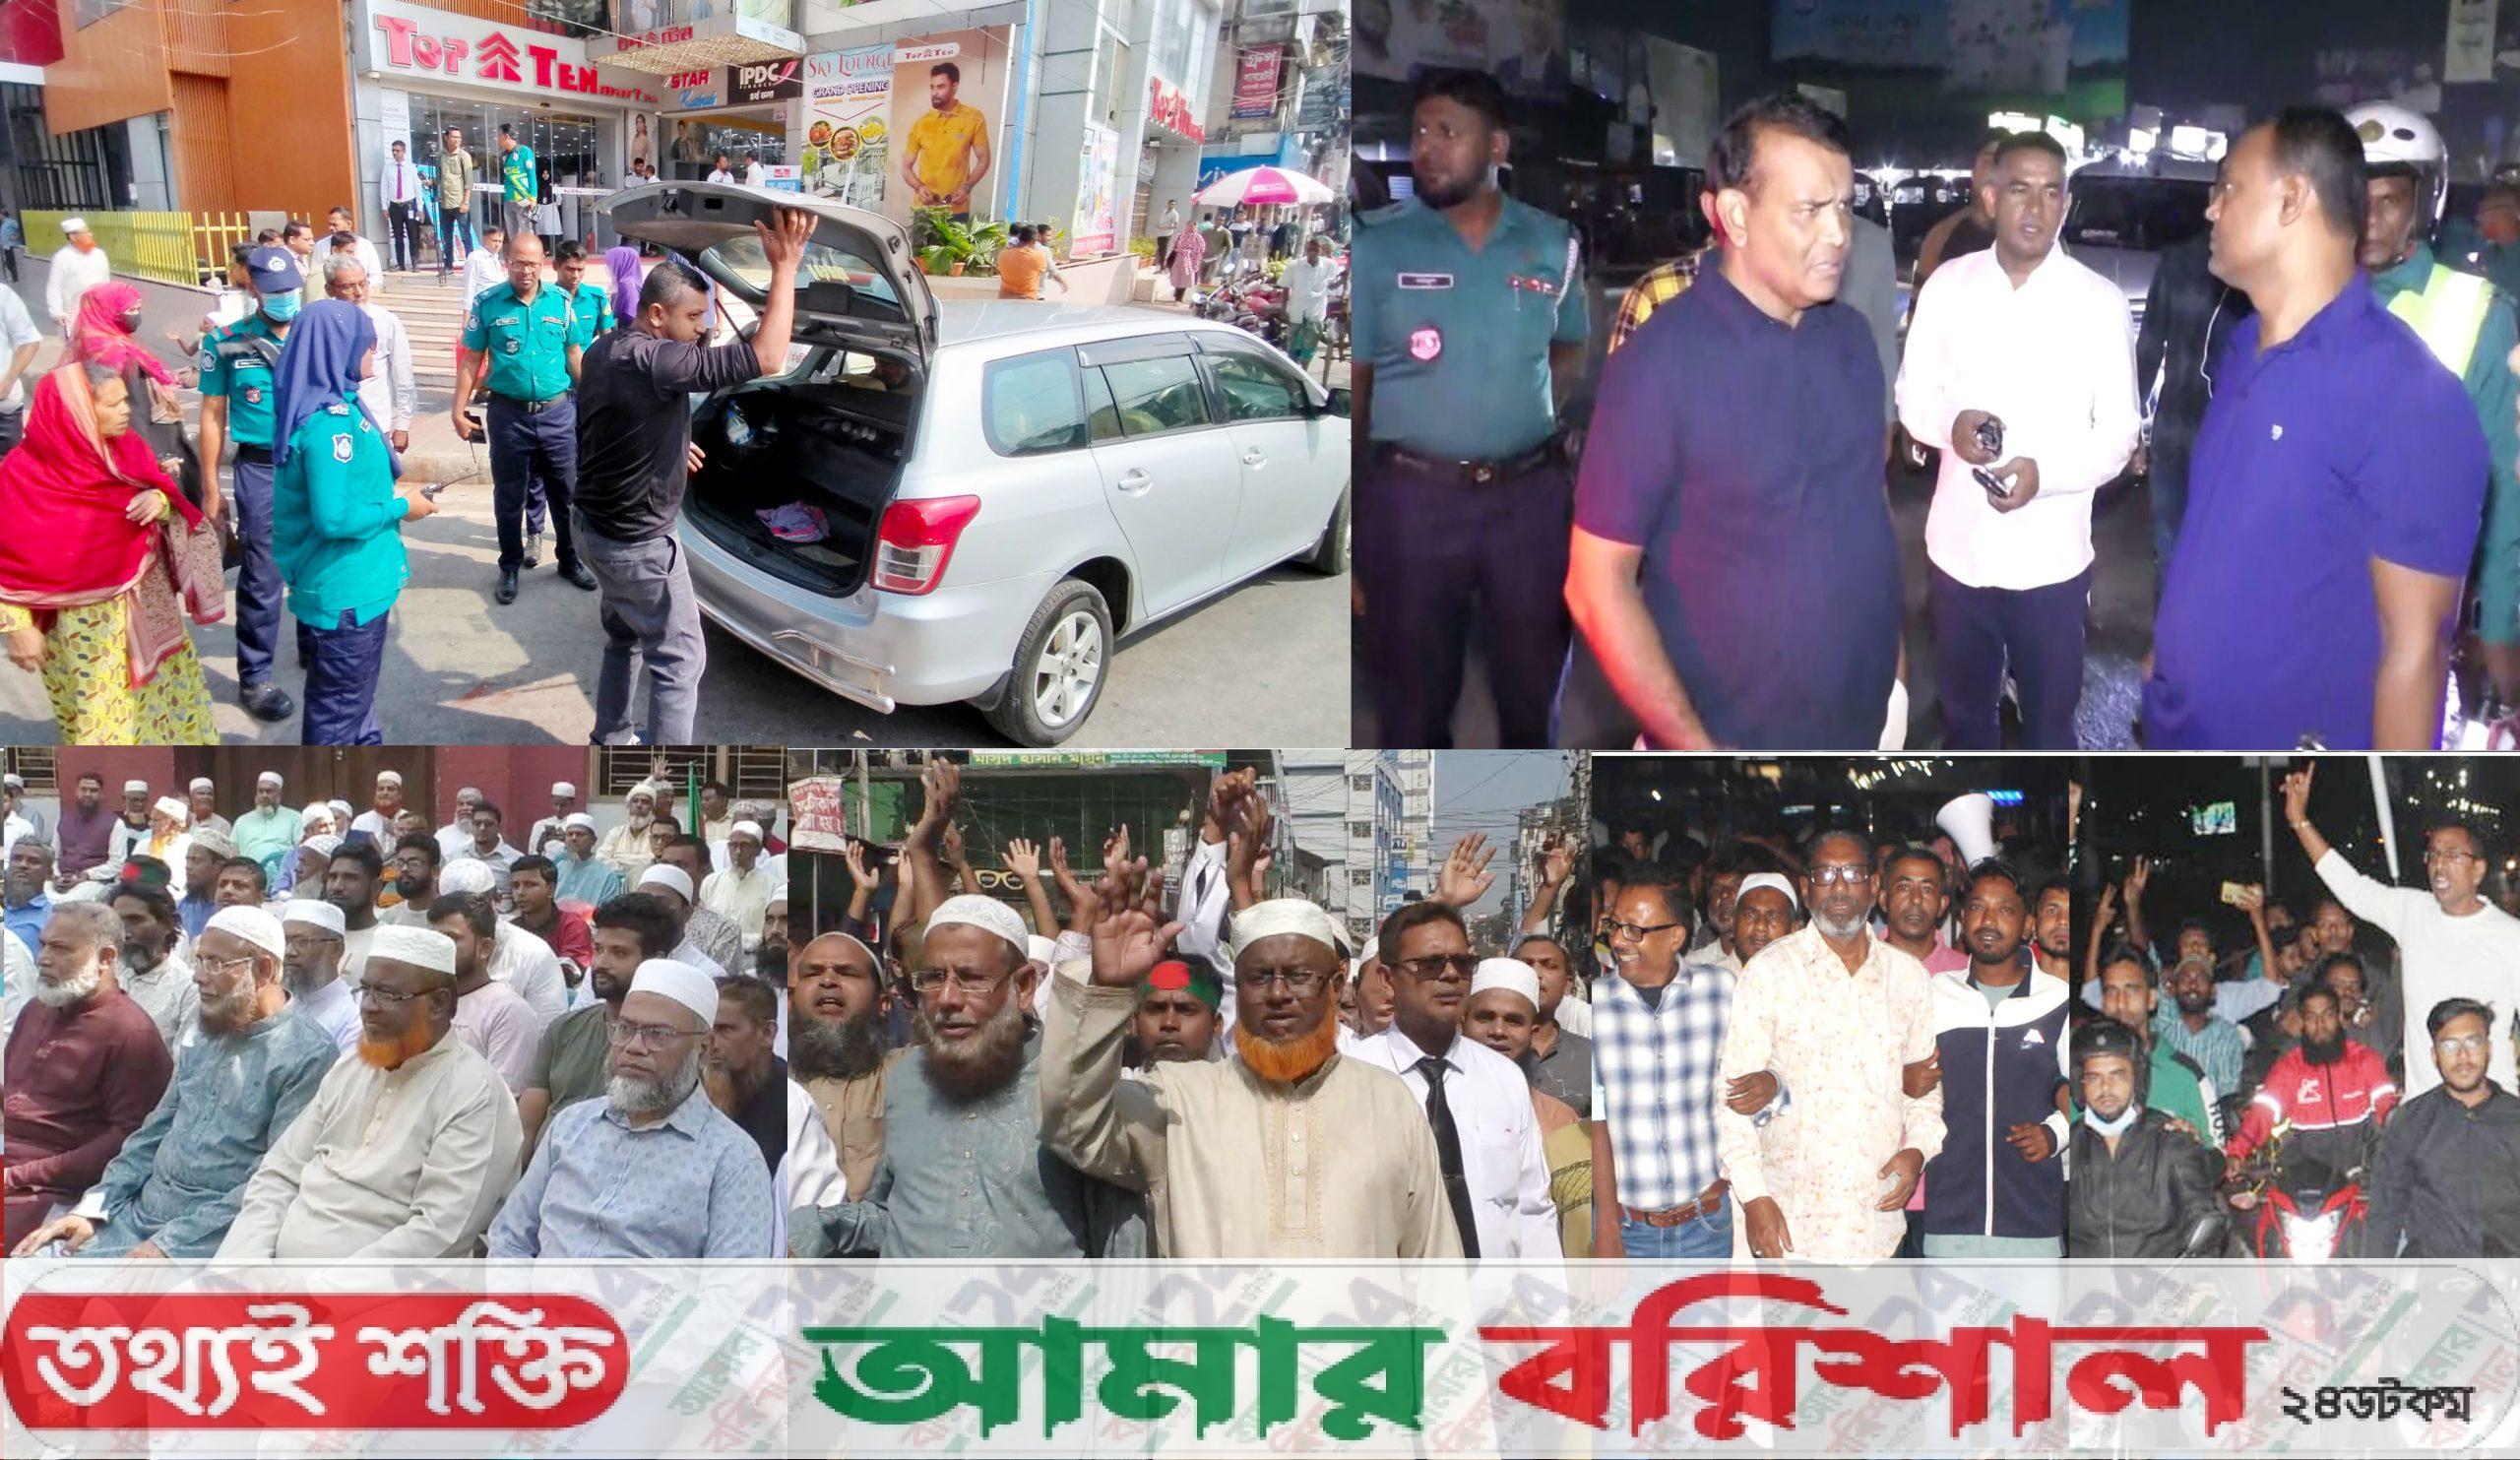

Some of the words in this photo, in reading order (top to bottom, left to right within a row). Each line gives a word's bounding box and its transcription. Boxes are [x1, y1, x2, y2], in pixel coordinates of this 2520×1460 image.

[739, 63, 779, 86] IPDC
[839, 52, 895, 77] LOUNGE
[671, 70, 710, 90] STAR
[812, 85, 846, 98] GRAND
[846, 80, 890, 95] OPENING
